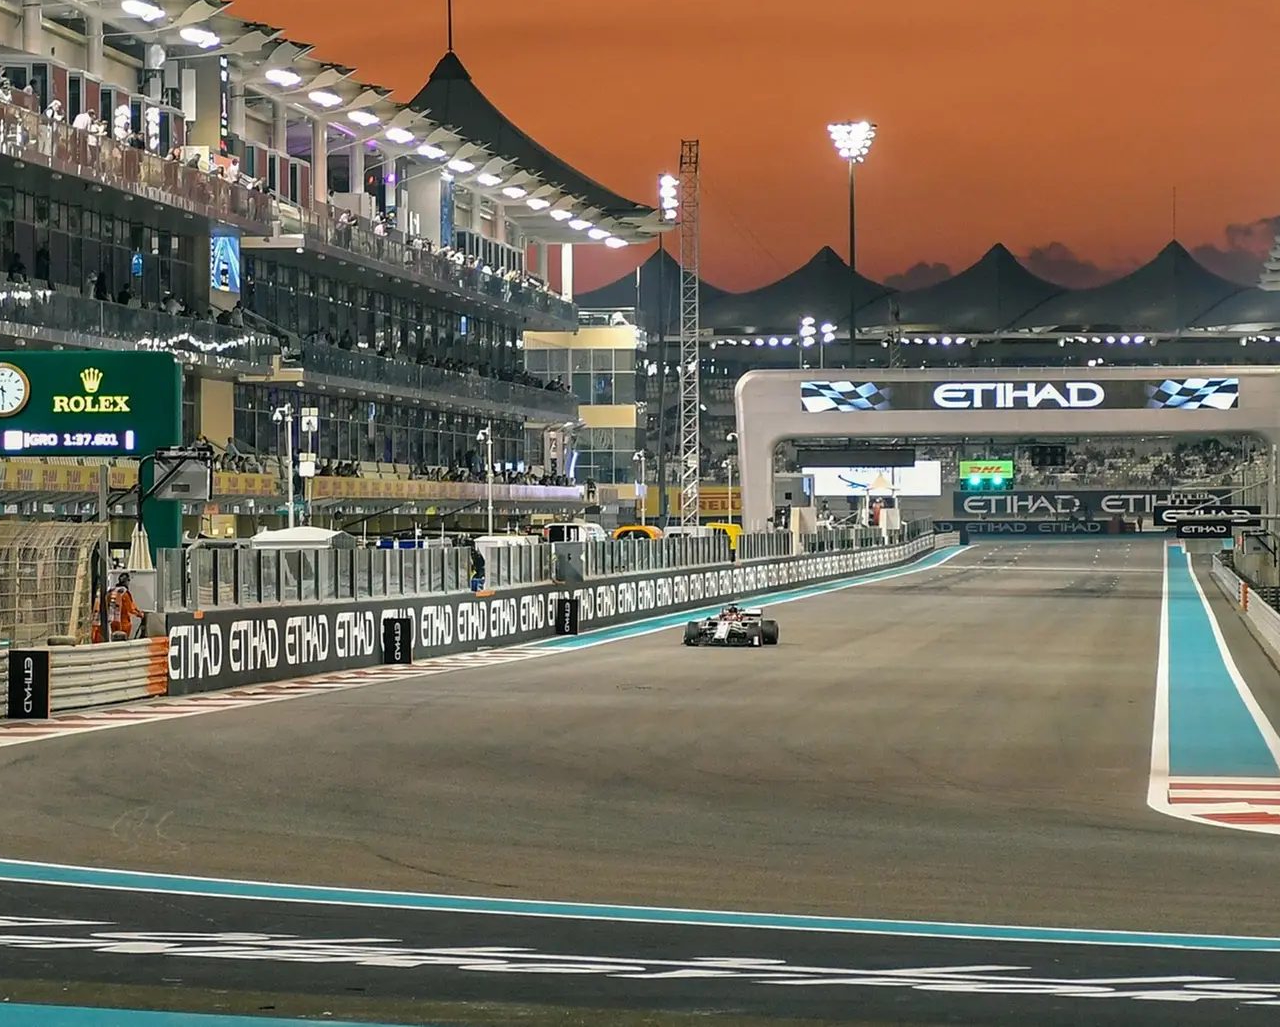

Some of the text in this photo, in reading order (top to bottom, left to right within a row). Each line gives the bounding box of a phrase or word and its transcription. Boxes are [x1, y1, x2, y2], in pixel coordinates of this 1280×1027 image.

[53, 395, 130, 413] ROLEX
[932, 382, 1105, 409] ETIHAD
[29, 434, 58, 447] GRO
[969, 466, 1003, 474] DHL
[963, 495, 1080, 514] ETIHAD
[965, 522, 1028, 533] ETIHAD
[1038, 522, 1101, 533] ETIHAD
[1181, 525, 1227, 534] ETIHAD
[168, 623, 223, 680] ETIHAD
[229, 618, 280, 672] ETIHAD
[285, 614, 330, 665] ETIHAD
[335, 610, 375, 658] ETIHAD
[420, 604, 453, 647] ETIHAD
[457, 601, 488, 642] ETIHAD
[490, 597, 517, 638] ETIHAD
[520, 593, 545, 632] ETIHAD
[394, 622, 402, 661] ETIHAD
[23, 656, 34, 714] ETIHAD
